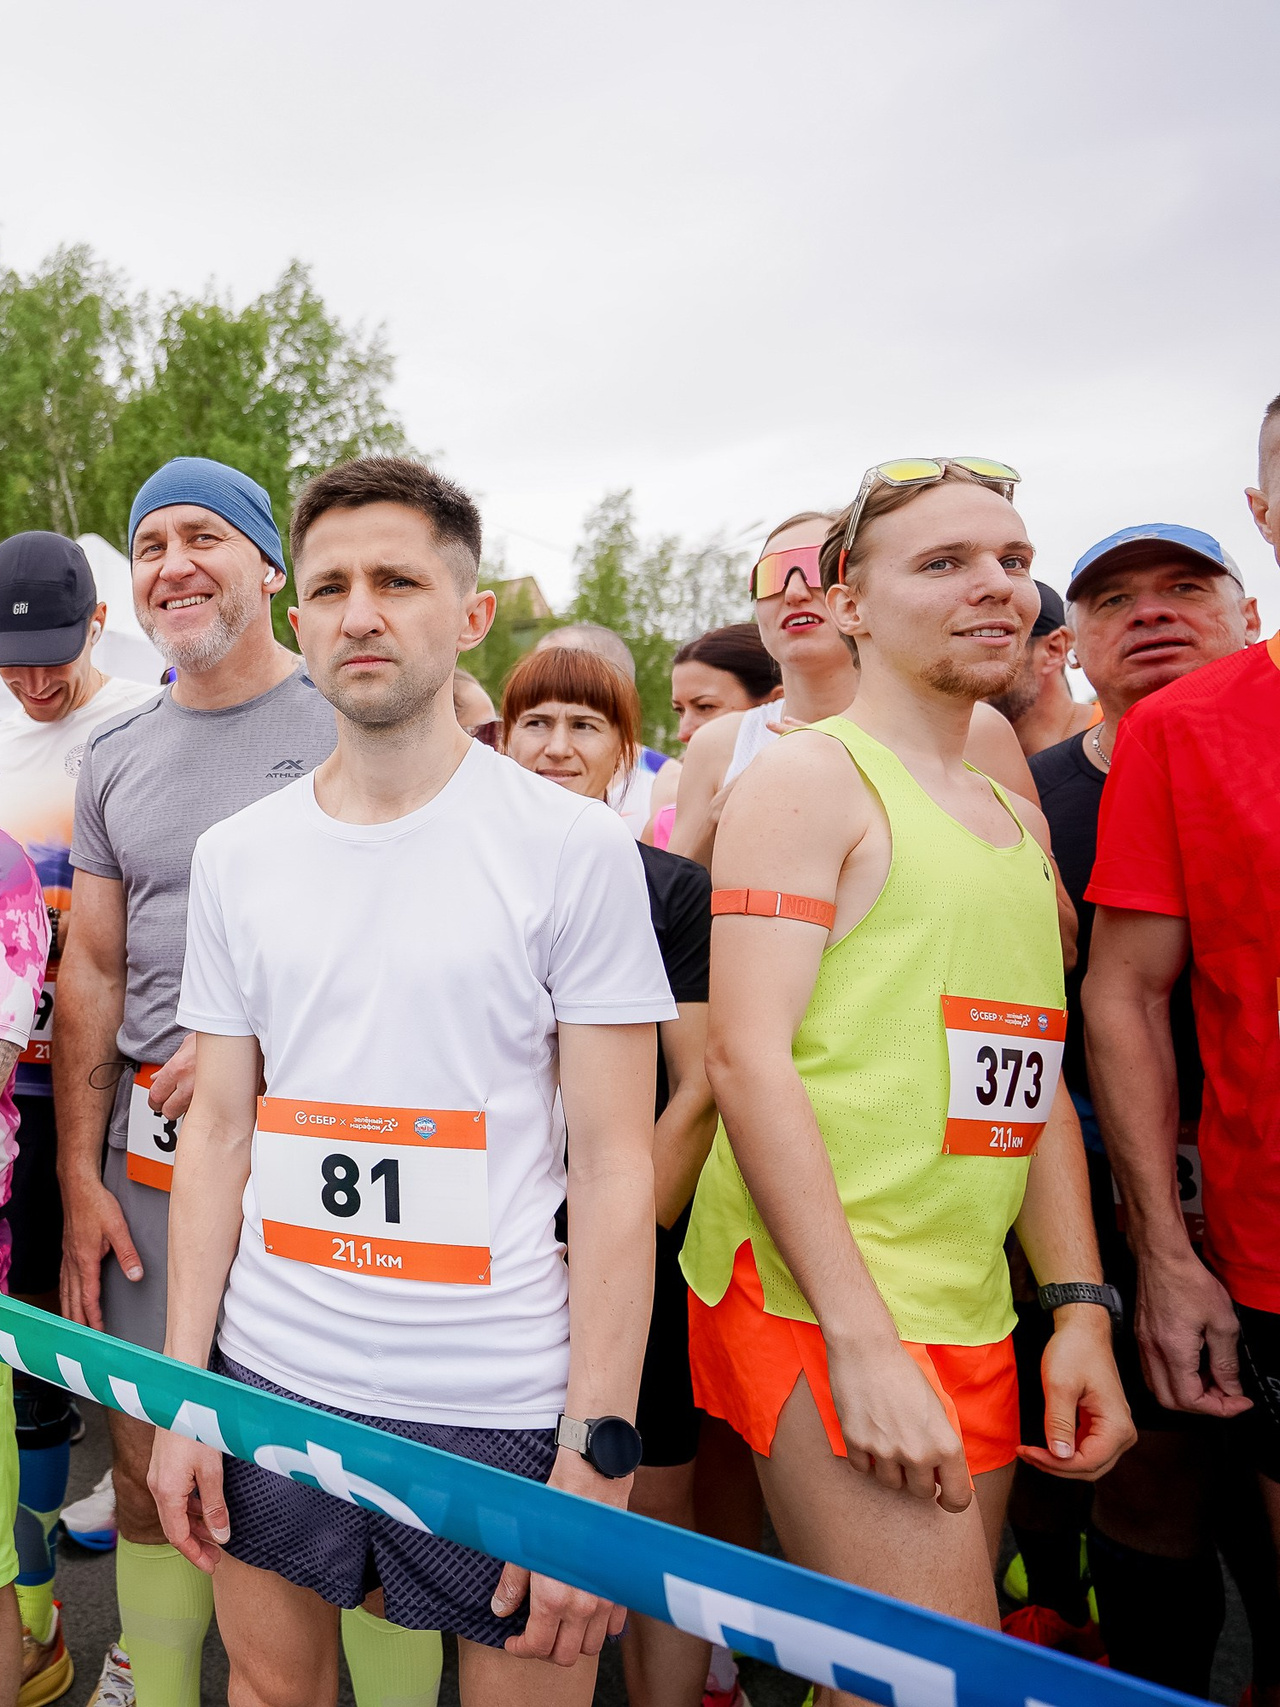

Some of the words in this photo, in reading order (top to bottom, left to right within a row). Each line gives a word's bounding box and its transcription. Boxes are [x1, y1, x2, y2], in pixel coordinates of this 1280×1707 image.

[976, 1045, 1044, 1109] 373
[308, 1114, 337, 1126] СБЕР
[321, 1153, 401, 1224] 81
